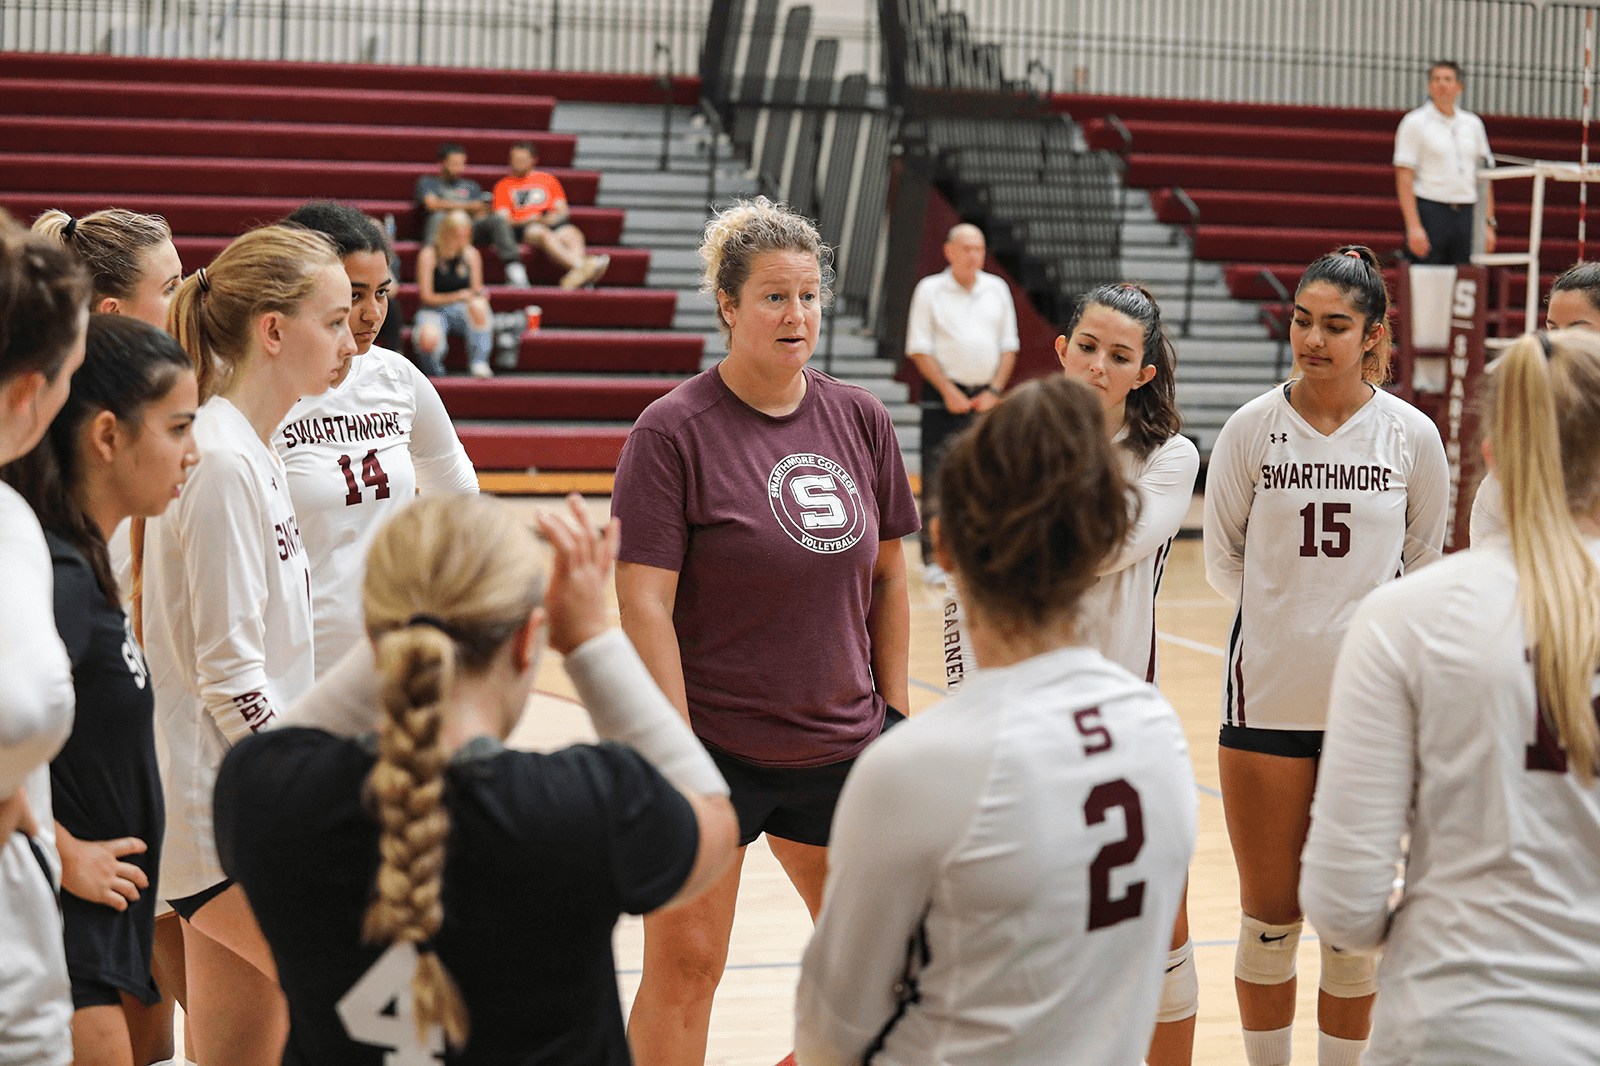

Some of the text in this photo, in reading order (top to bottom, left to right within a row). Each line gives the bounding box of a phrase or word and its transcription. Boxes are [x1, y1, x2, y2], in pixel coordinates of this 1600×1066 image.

[1453, 278, 1477, 318] S
[337, 448, 390, 507] 14
[770, 456, 858, 499] SWARTHMORE COLLEGE
[788, 473, 849, 530] S
[1261, 462, 1392, 492] SWARTHMORE
[800, 533, 857, 551] VOLLEYBALL
[1299, 502, 1351, 558] 15
[1084, 777, 1146, 932] 2
[335, 939, 446, 1066] 4
